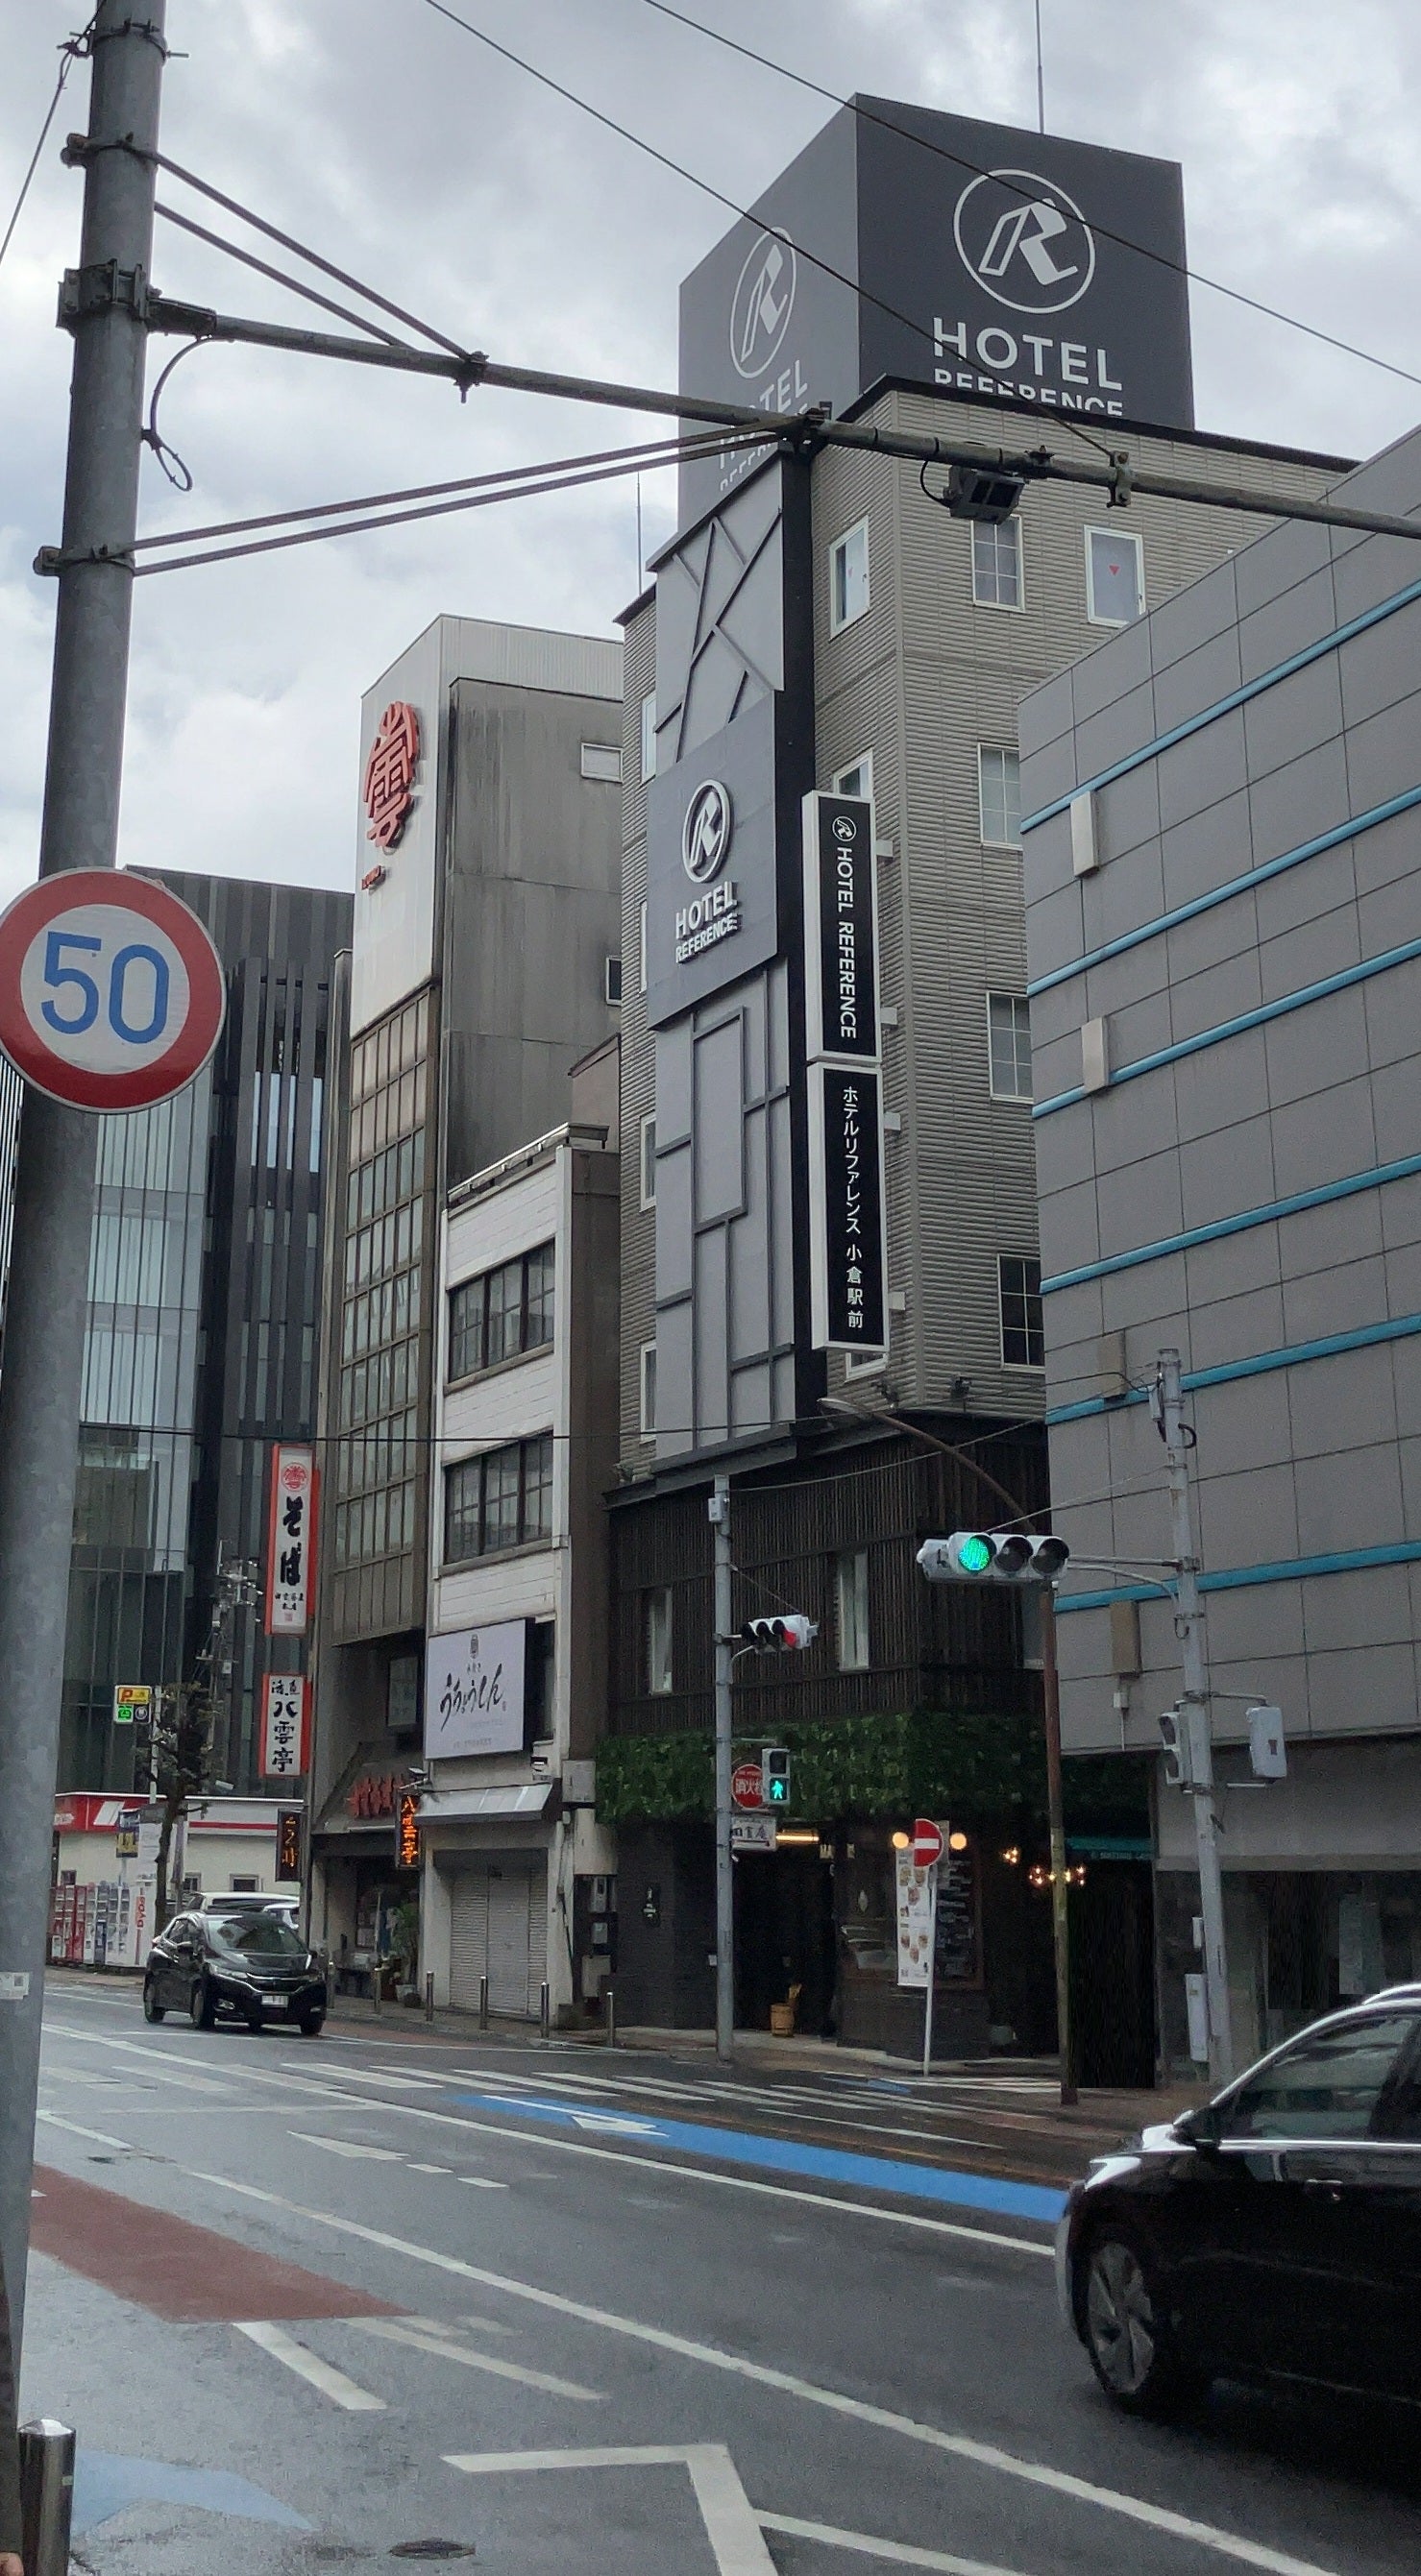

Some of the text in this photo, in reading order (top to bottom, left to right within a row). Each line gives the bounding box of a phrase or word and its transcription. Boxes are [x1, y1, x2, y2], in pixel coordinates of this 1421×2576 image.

[933, 317, 1123, 391] HOTEL
[675, 881, 738, 940] HOTEL
[675, 912, 740, 963] REFERENCE
[837, 846, 857, 1039] HOTEL REFERENCE
[40, 931, 170, 1045] 50
[842, 1086, 864, 1329] ホテルリファレンス 小倉駅前
[280, 1495, 304, 1586] そば
[271, 1700, 299, 1773] 八雲亭
